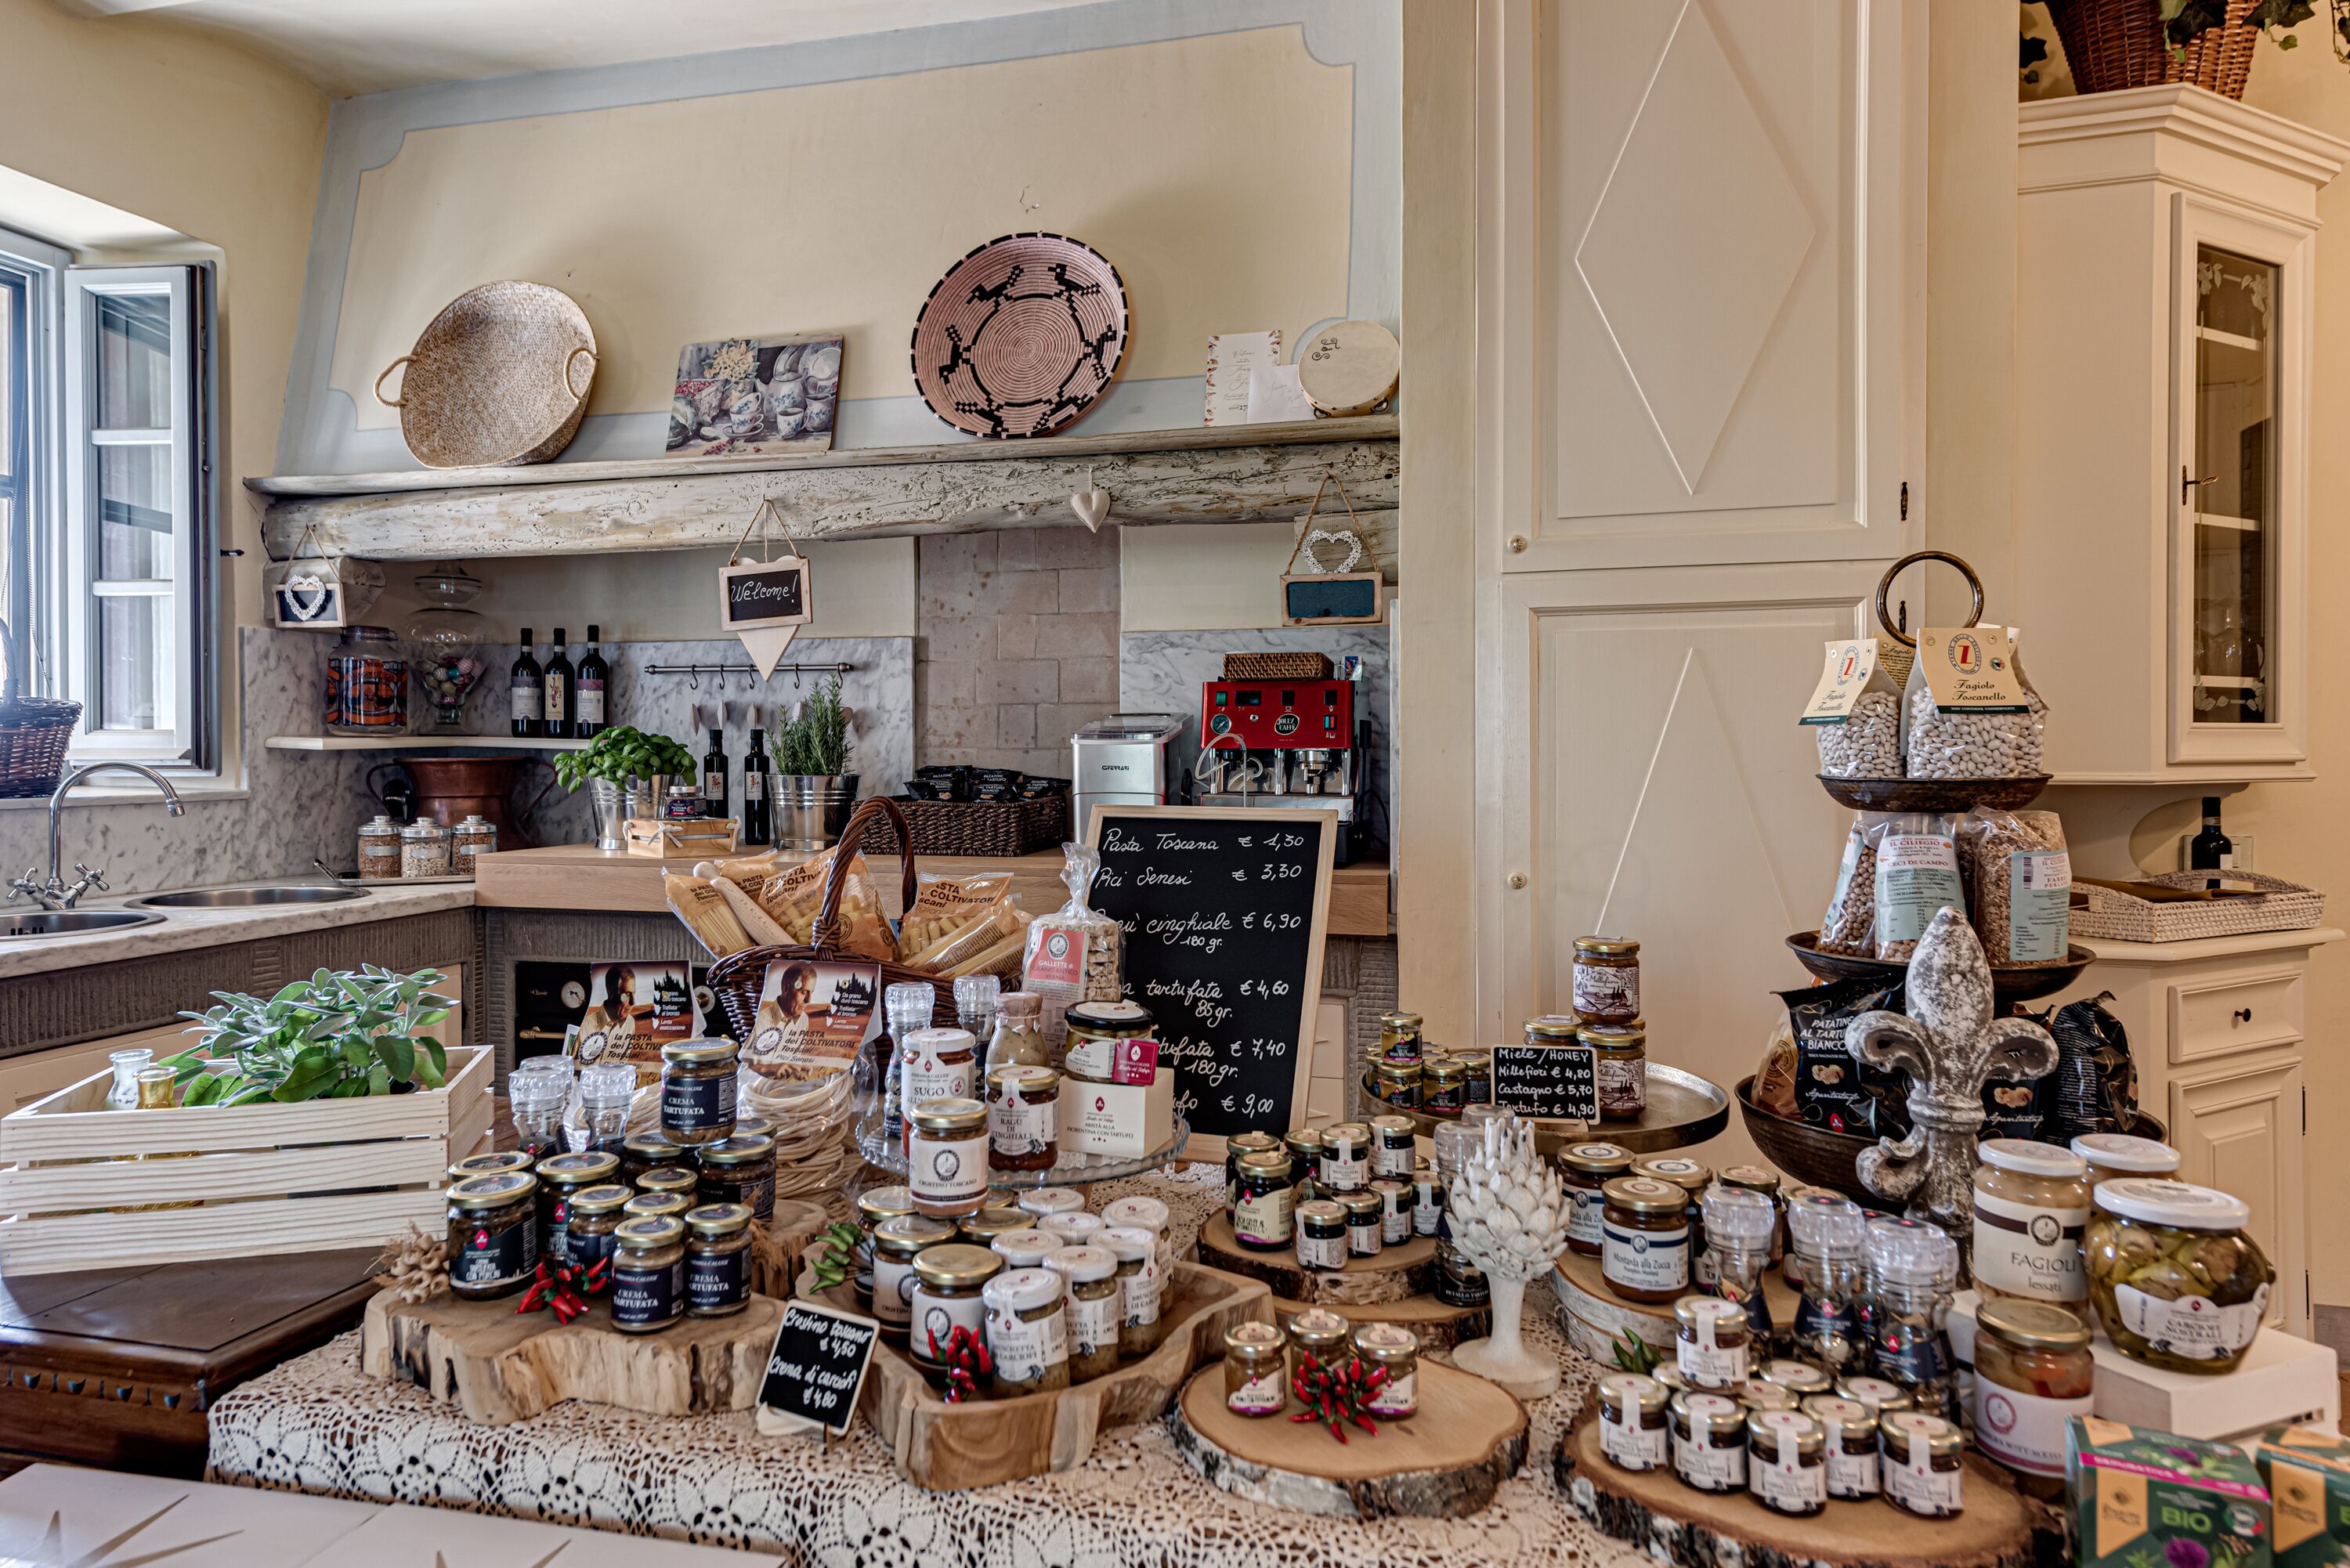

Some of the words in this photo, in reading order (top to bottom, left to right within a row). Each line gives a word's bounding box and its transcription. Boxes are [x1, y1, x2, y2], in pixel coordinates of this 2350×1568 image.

[730, 574, 798, 603] Welcome!
[1954, 680, 1994, 691] Fagiolo
[1952, 691, 2005, 700] Toscanello
[1102, 828, 1144, 853] Pasta
[1156, 833, 1219, 851] Toscana
[1238, 835, 1253, 847] €
[1263, 833, 1304, 851] 1,30
[743, 875, 764, 883] PASTA
[1095, 868, 1128, 890] Pici
[1137, 867, 1193, 887] Senesi
[1232, 869, 1248, 881] €
[1260, 864, 1302, 882] 3,30
[918, 898, 947, 908] scani
[931, 890, 994, 904] COLTIVATOR
[1147, 912, 1233, 945] cinghiale
[1242, 912, 1256, 929] €
[1263, 913, 1301, 933] 6,90
[1147, 980, 1224, 1006] tartufata
[1240, 980, 1253, 995] €
[1257, 983, 1289, 999] 4,60
[1816, 1029, 1846, 1039] TARTU
[801, 1039, 855, 1048] COLTIVATORI
[1159, 1036, 1215, 1064] tufata
[1230, 1041, 1242, 1057] €
[1252, 1038, 1285, 1060] 7,40
[1808, 1040, 1847, 1050] BIANCO
[1499, 1048, 1537, 1060] Miele
[1499, 1064, 1549, 1079] Millefiori
[1551, 1067, 1561, 1078] €
[1565, 1068, 1591, 1081] 4,80
[914, 1086, 945, 1096] SUGO
[1498, 1082, 1552, 1100] Castagno
[1554, 1084, 1565, 1095] €
[1567, 1085, 1593, 1097] 5,70
[669, 1097, 695, 1105] CREMA
[1221, 1098, 1236, 1113] €
[1242, 1094, 1274, 1118] 9,00
[663, 1105, 704, 1115] TARTUFATA
[1498, 1100, 1548, 1115] Tartufo
[1553, 1104, 1564, 1115] €
[1567, 1103, 1595, 1118] 4,90
[1067, 1126, 1096, 1135] FIORENTINA
[918, 1180, 947, 1188] CROSTINO
[949, 1179, 977, 1187] TOSCANO
[1641, 1259, 1651, 1269] alla
[1653, 1259, 1671, 1270] Zucca
[2011, 1251, 2077, 1272] FAGIOLI
[690, 1274, 719, 1283] CREMA
[617, 1288, 649, 1299] CREMA
[689, 1282, 729, 1292] ARTUFATA
[613, 1295, 659, 1308] TARTUFATA
[783, 1308, 828, 1335] Crostino
[830, 1320, 873, 1343] toscano
[819, 1337, 829, 1351] €
[831, 1338, 856, 1360] 4,50
[769, 1355, 802, 1380] Crema
[804, 1364, 820, 1385] di
[803, 1386, 814, 1405] €
[814, 1388, 837, 1409] 4,80
[2161, 1505, 2212, 1534] BIO
